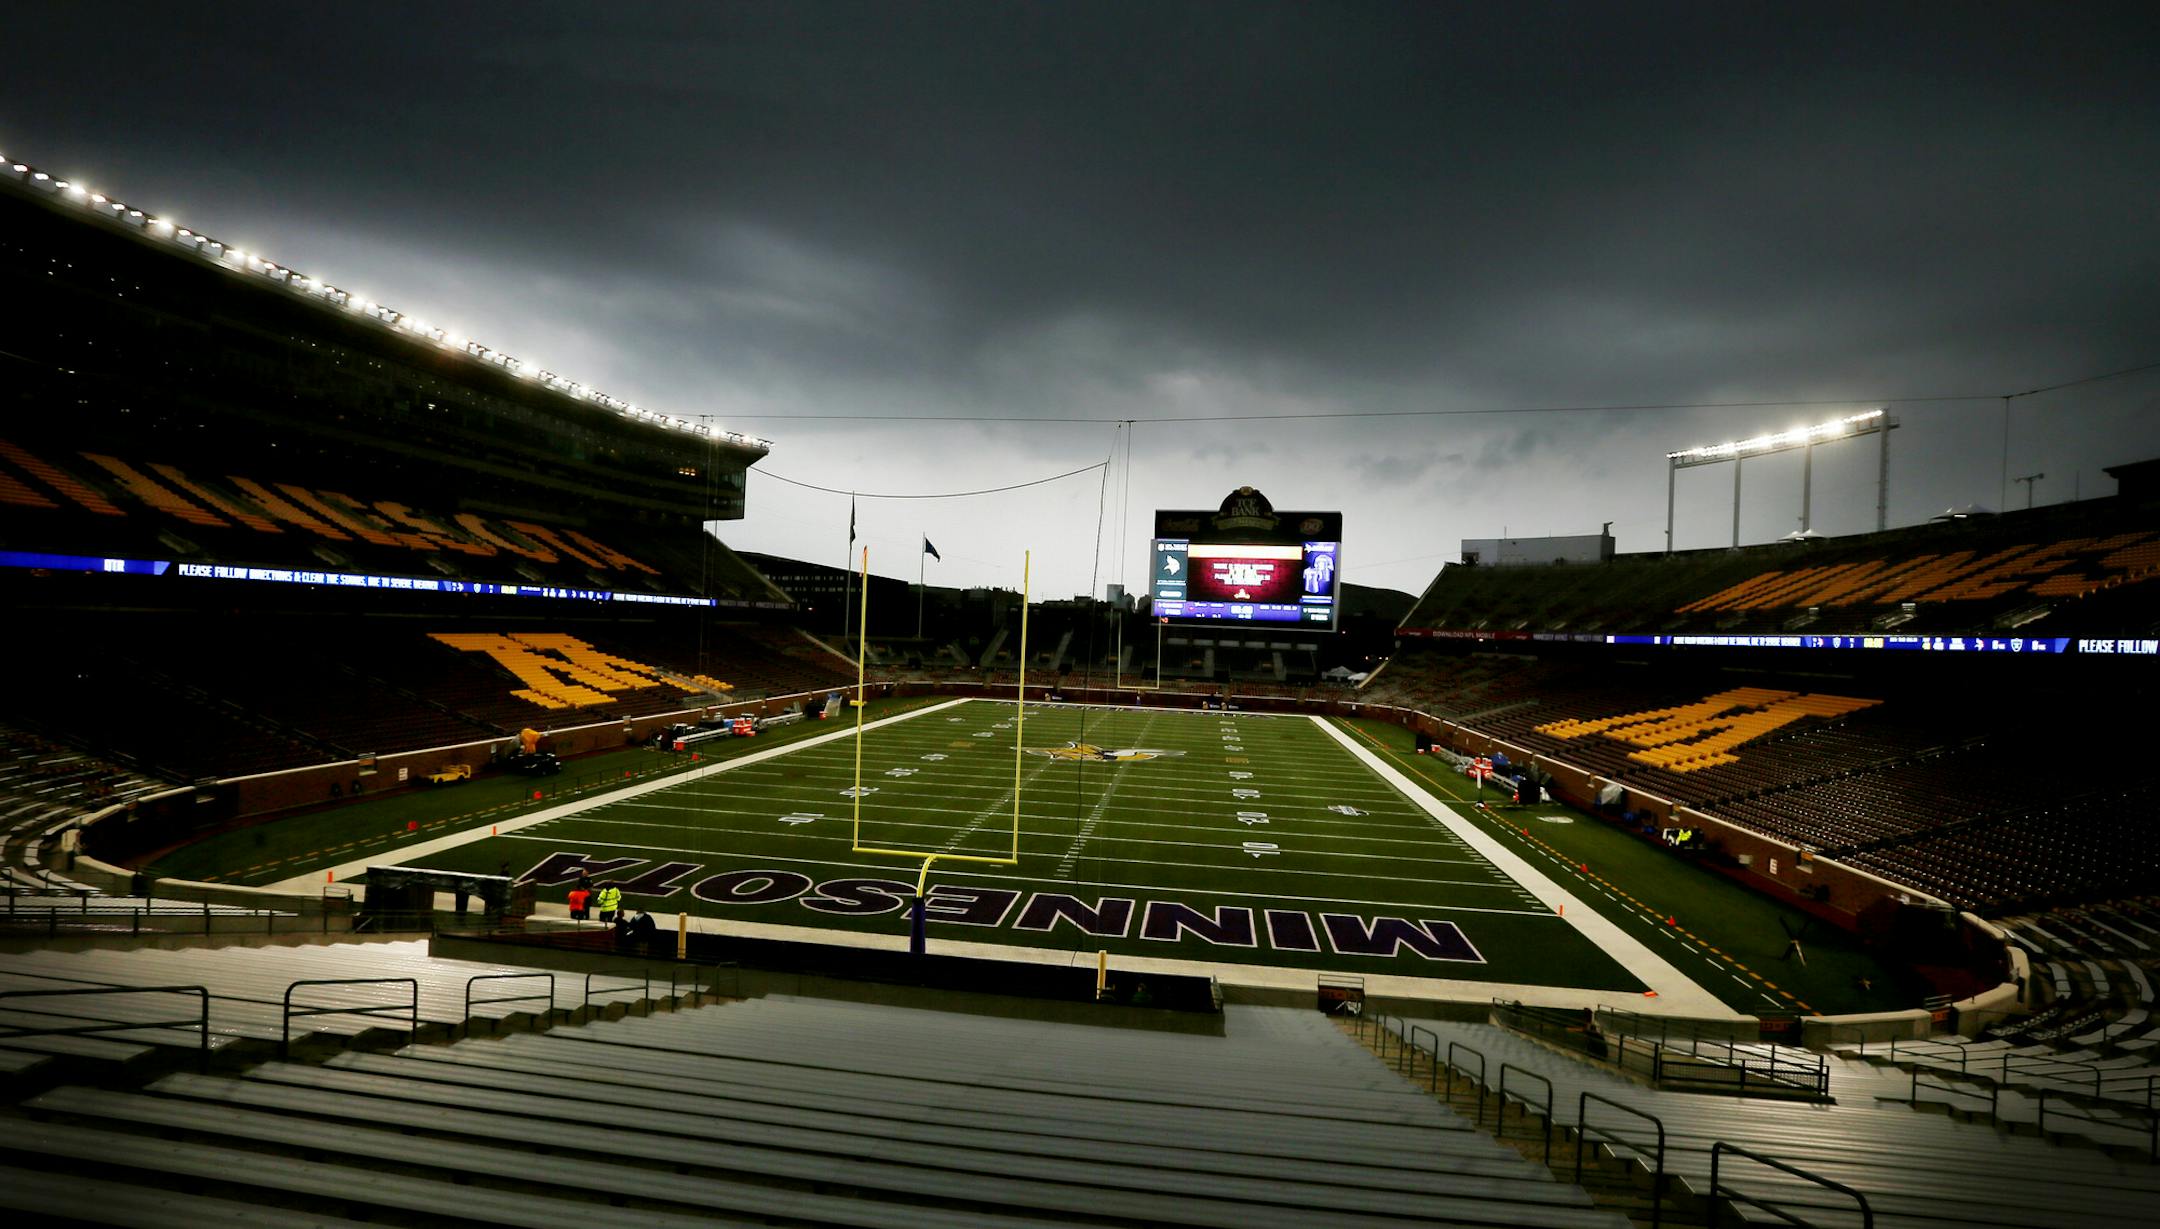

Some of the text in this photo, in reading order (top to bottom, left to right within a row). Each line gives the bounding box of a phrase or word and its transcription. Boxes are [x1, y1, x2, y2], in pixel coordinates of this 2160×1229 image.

[1231, 506, 1260, 517] BANK
[179, 564, 212, 577] PLEASE
[214, 566, 248, 579] FOLLOW
[1432, 631, 1464, 639] DOWNLOAD
[2079, 639, 2159, 654] PLEASE FOLLOW
[514, 851, 1490, 964] MINNESOTA
